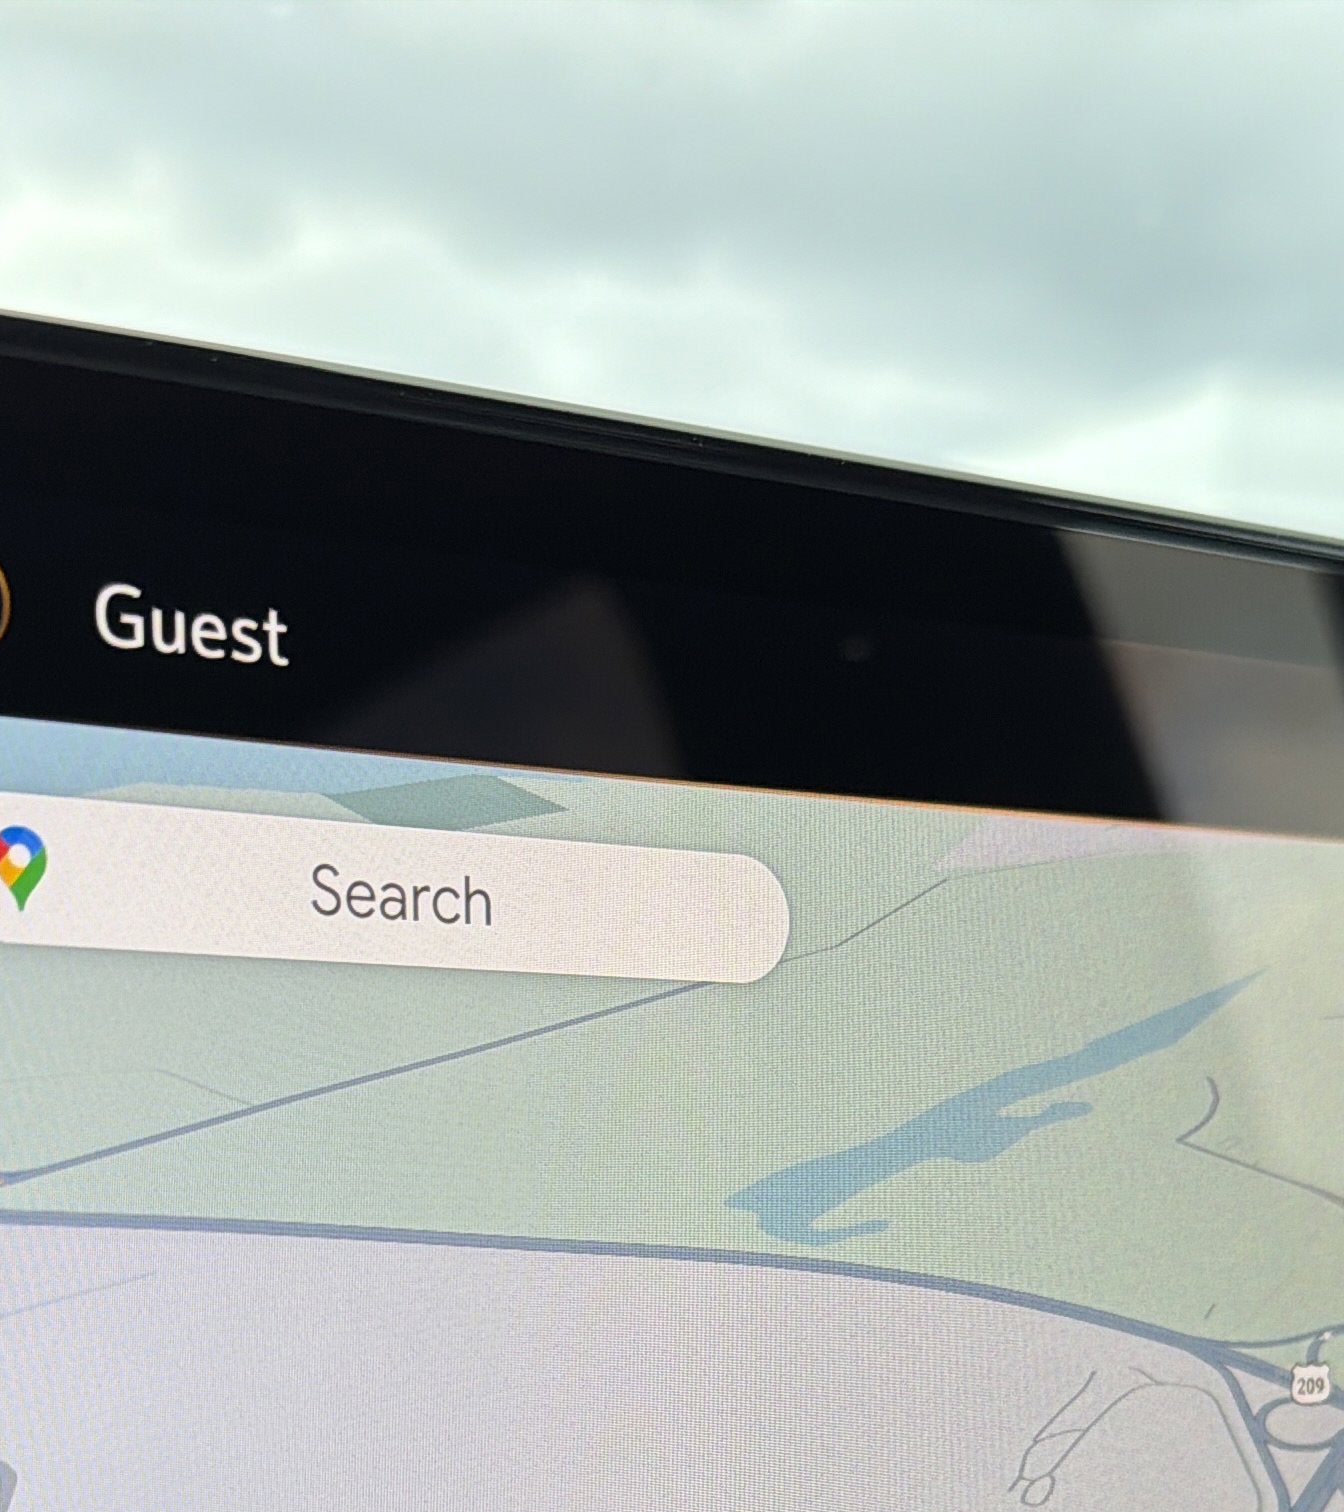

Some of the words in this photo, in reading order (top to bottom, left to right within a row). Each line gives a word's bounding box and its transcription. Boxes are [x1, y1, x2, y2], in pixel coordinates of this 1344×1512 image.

[94, 583, 290, 667] Guest
[311, 863, 493, 927] Search
[1297, 1376, 1325, 1396] 209
